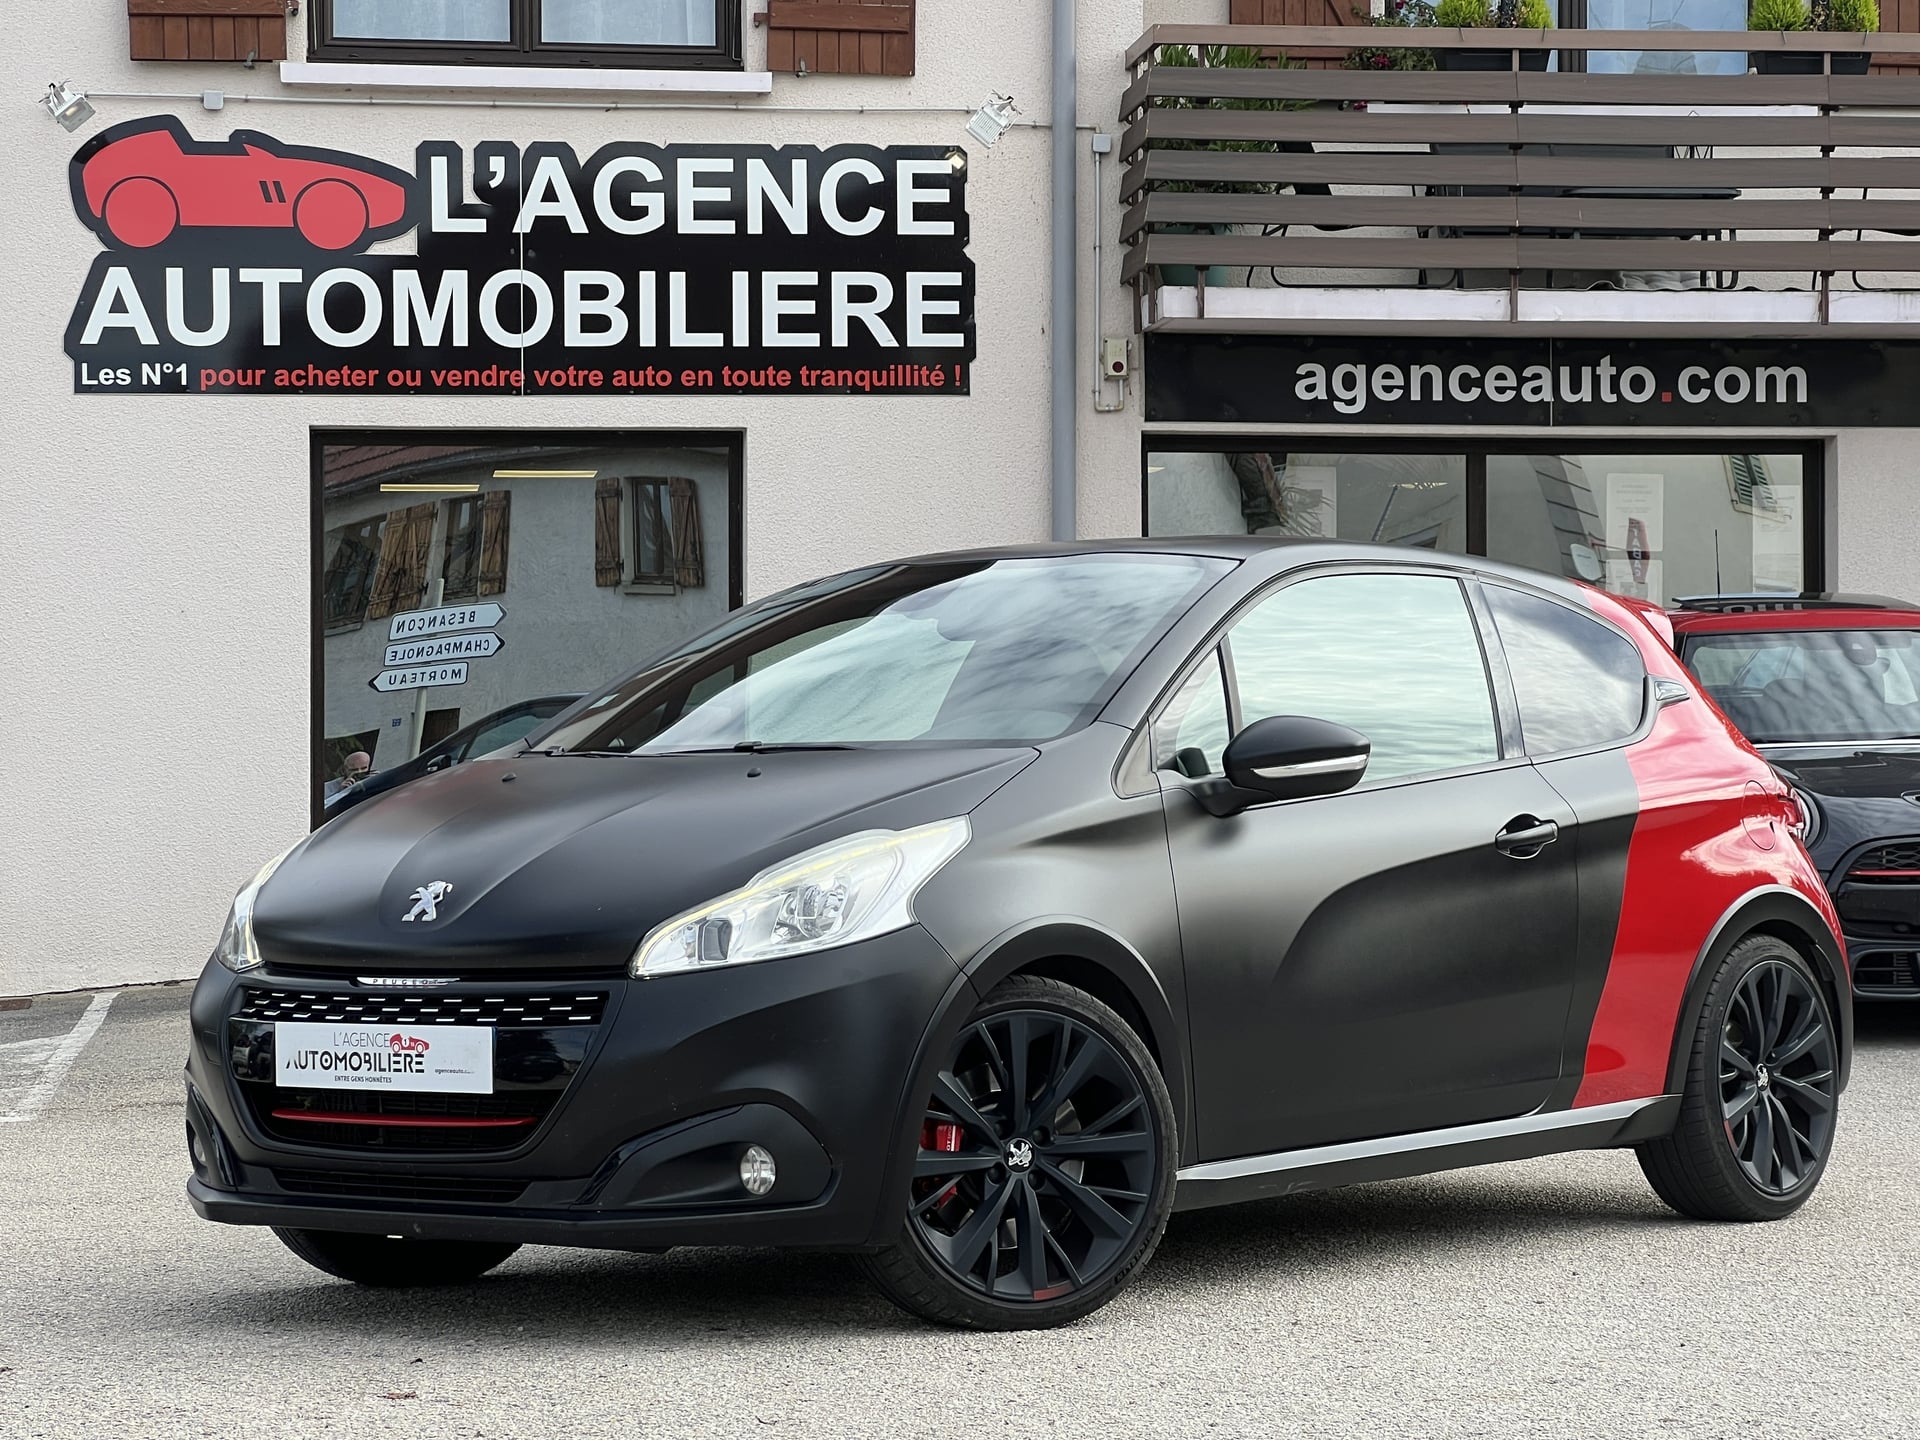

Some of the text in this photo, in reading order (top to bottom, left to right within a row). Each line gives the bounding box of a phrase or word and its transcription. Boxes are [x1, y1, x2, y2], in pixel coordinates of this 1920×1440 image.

[430, 155, 955, 236] L'AGENCE
[79, 266, 965, 349] AUTOMOBILIERE
[81, 362, 961, 391] Les N°1 pour acheter ou vendre votre auto en toute tranquillité !
[1295, 355, 1808, 414] agenceauto.com
